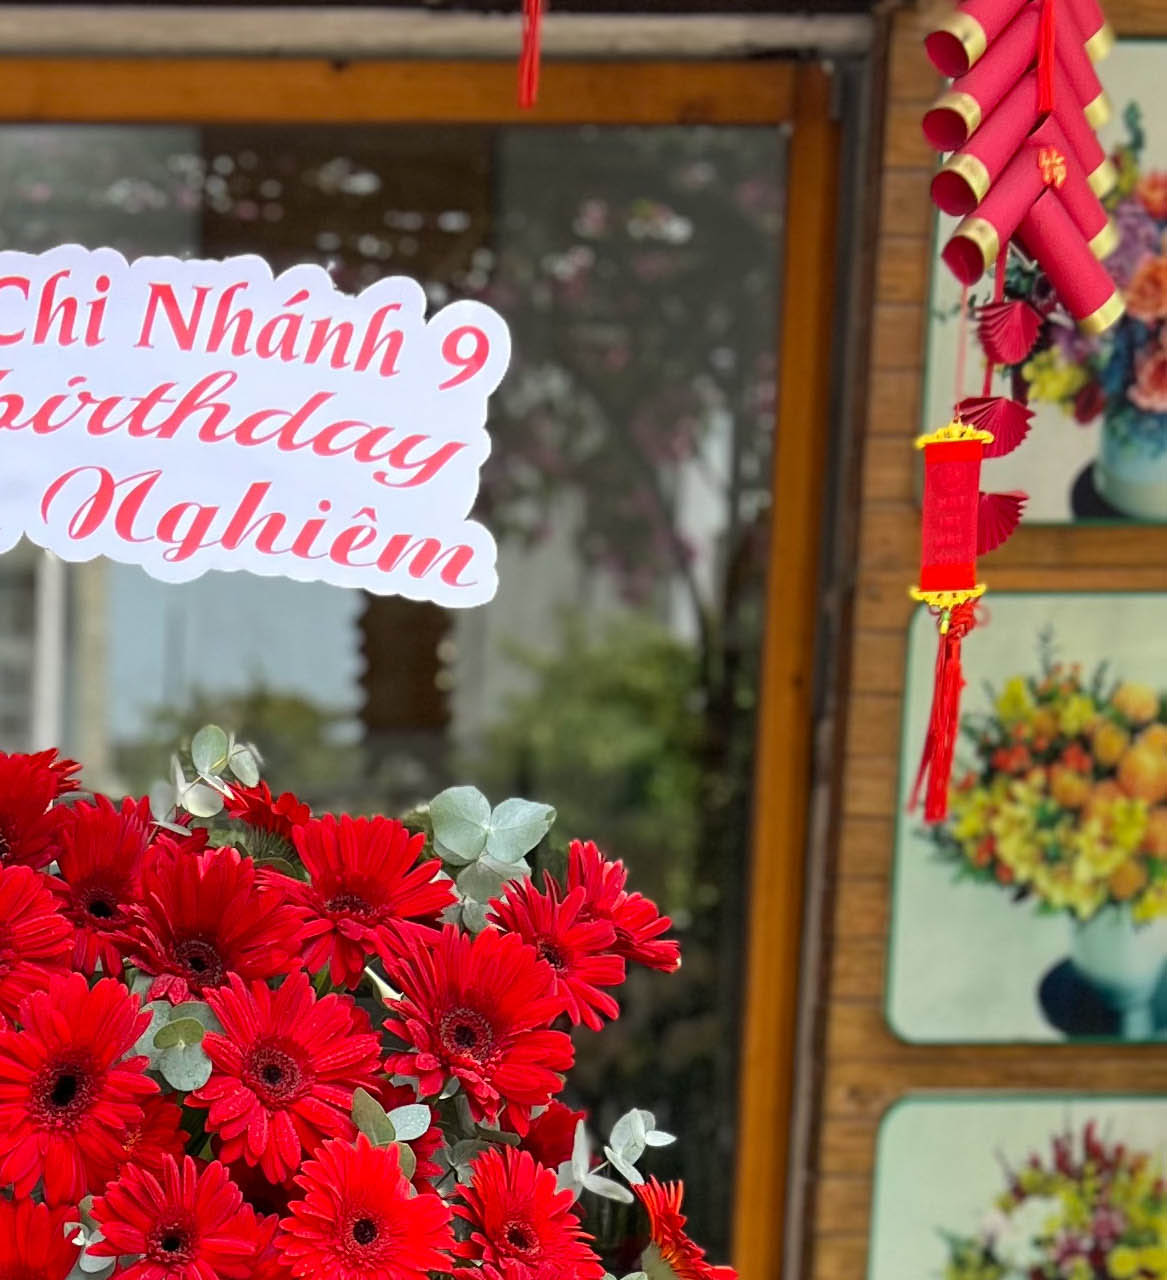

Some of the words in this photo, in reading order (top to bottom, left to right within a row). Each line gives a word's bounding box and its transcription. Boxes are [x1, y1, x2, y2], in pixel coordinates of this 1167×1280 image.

[135, 280, 406, 379] Nhánh
[439, 324, 491, 391] 9
[39, 465, 479, 590] Nghiêm
